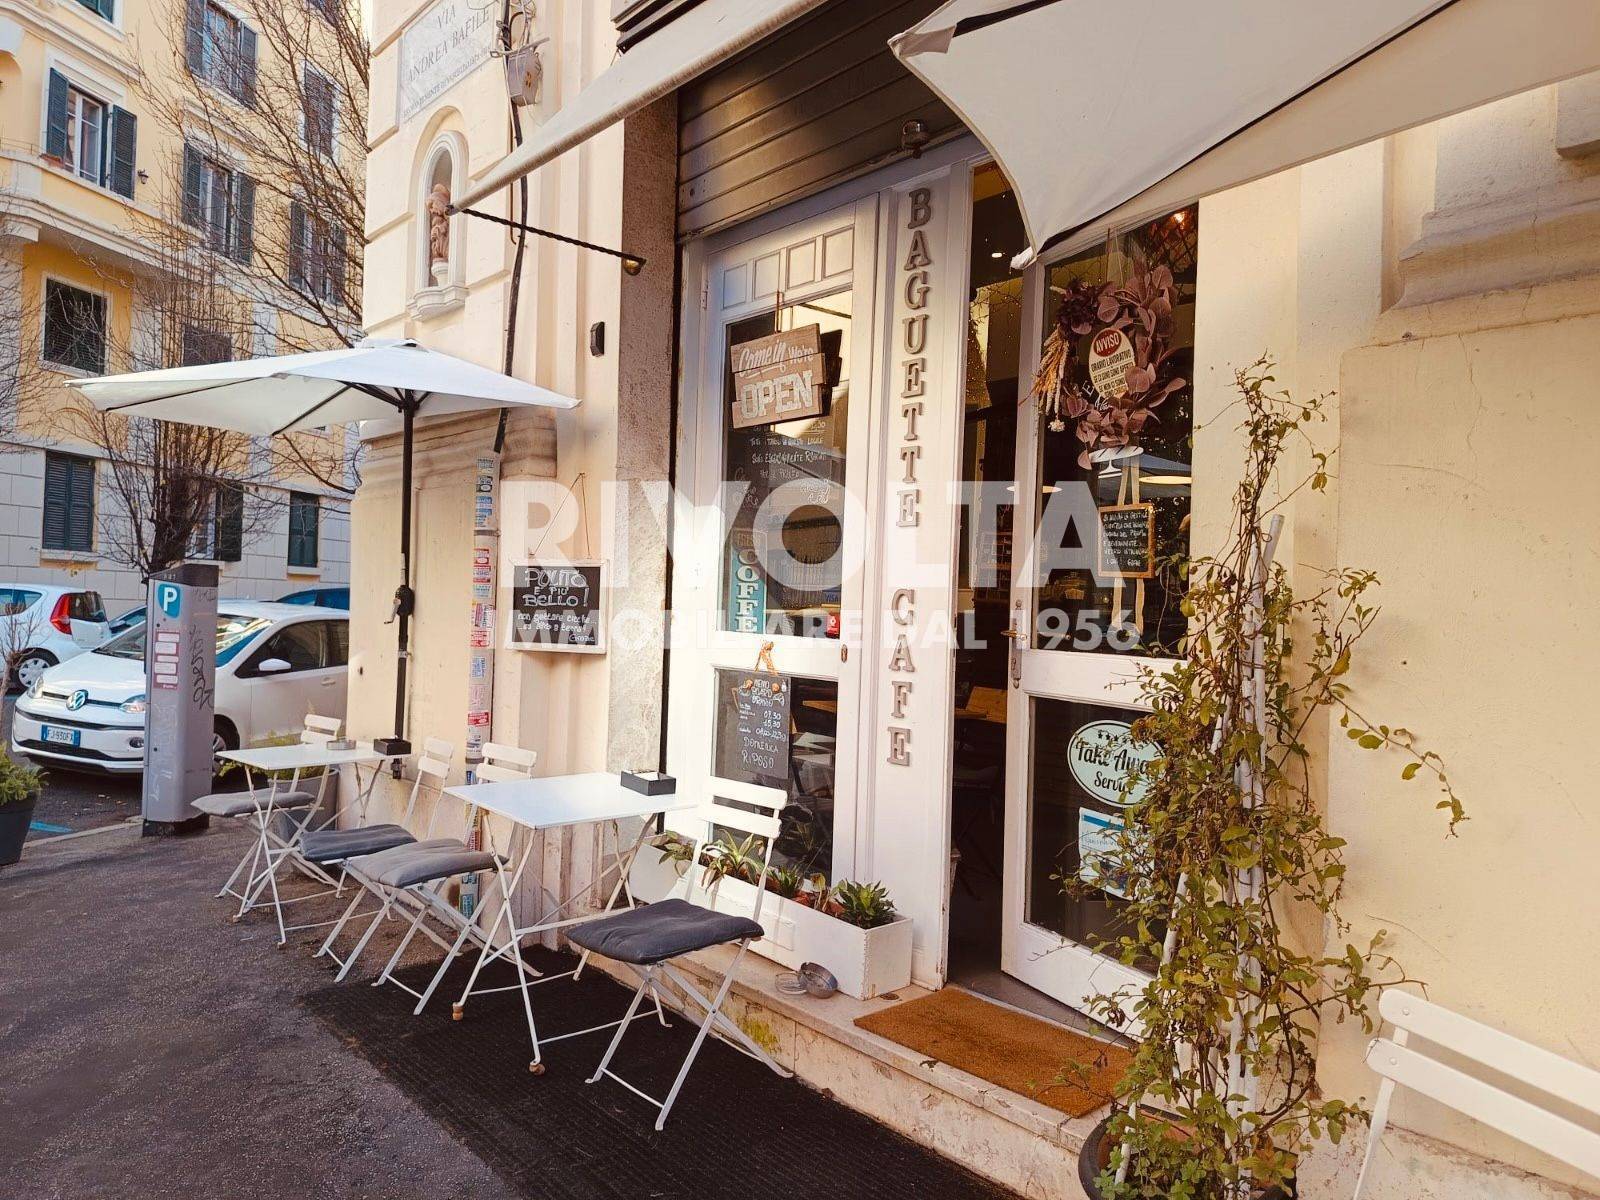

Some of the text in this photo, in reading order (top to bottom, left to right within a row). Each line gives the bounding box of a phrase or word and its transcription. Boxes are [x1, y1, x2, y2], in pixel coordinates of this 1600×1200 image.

[437, 4, 456, 29] VIA
[409, 8, 489, 82] ANDREA BAFILE
[1096, 332, 1120, 354] AVVISO
[738, 345, 774, 378] Come
[788, 345, 814, 364] We're
[1106, 348, 1132, 367] LAVORATIVO
[740, 369, 814, 420] OPEN
[887, 188, 932, 767] BAGUETTE CAFE
[163, 586, 178, 612] P
[825, 593, 840, 603] VISA
[1076, 738, 1148, 775] Take Awa
[1094, 770, 1134, 795] Servi
